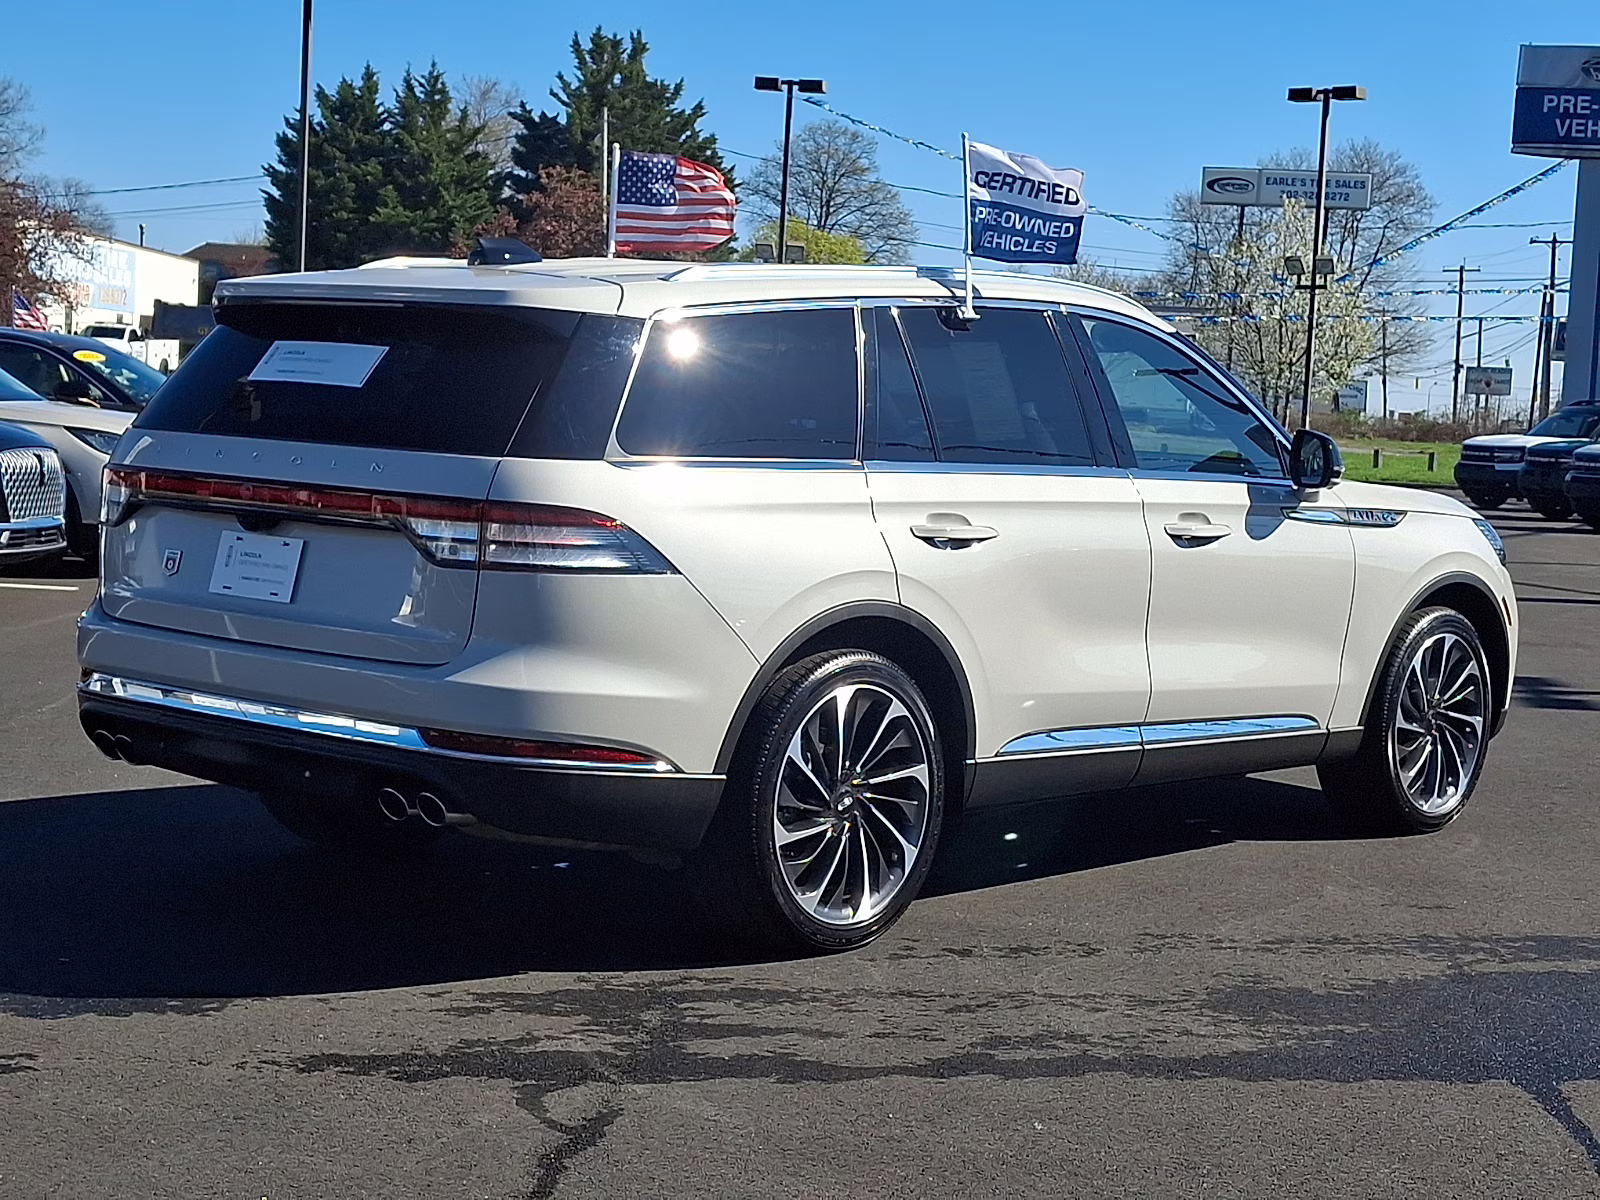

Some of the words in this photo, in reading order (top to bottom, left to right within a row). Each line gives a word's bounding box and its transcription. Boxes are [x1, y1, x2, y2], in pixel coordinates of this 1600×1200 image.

[1555, 119, 1600, 138] VEH
[974, 170, 1081, 206] CERTIFIED
[1265, 176, 1307, 187] EARLE'S
[1310, 178, 1331, 188] TE
[1334, 179, 1366, 190] SALES
[974, 206, 1074, 238] PRE-OWNED
[980, 230, 1058, 255] VEHICLES
